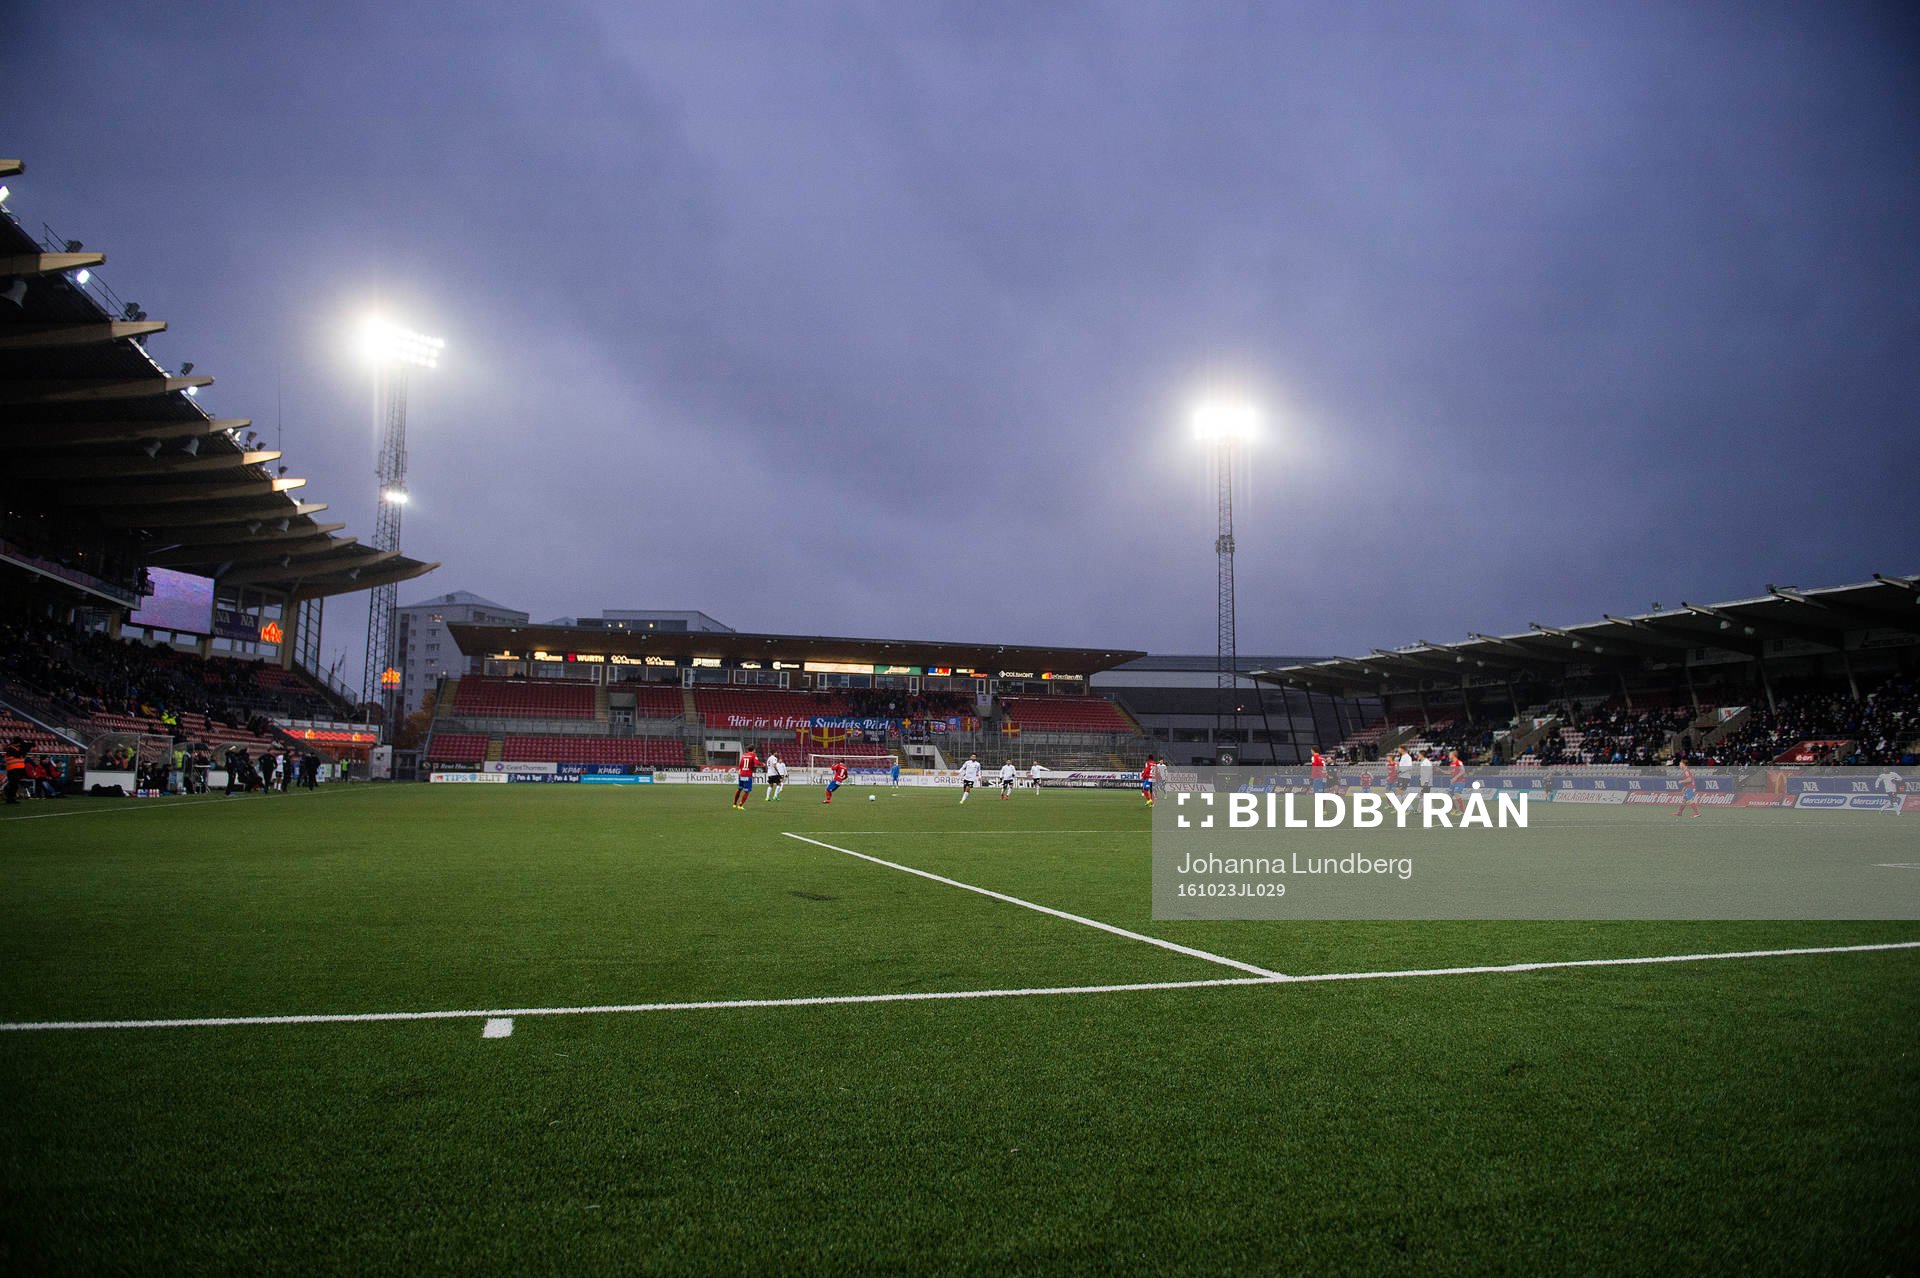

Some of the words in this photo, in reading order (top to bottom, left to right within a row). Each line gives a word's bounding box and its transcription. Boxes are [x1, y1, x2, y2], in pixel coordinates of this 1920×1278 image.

[728, 715, 752, 728] Här
[754, 717, 769, 728] är
[773, 716, 783, 728] vi
[784, 715, 811, 730] från
[814, 716, 860, 731] Sundets
[598, 767, 621, 775] KPMG
[479, 774, 502, 782] ELIT
[1503, 780, 1514, 788] NA
[1532, 780, 1543, 788] NA
[1562, 780, 1574, 789] NA
[1594, 780, 1607, 789] NA
[1629, 780, 1642, 790] NA
[1666, 780, 1679, 790] NA
[1705, 780, 1720, 790] NA
[1803, 781, 1820, 792] NA
[1852, 781, 1870, 792] NA
[1905, 781, 1920, 793] NA
[1671, 793, 1699, 804] svek
[1803, 797, 1827, 805] Mercuri
[1827, 797, 1845, 805] Urval
[1852, 798, 1877, 806] Mercuri
